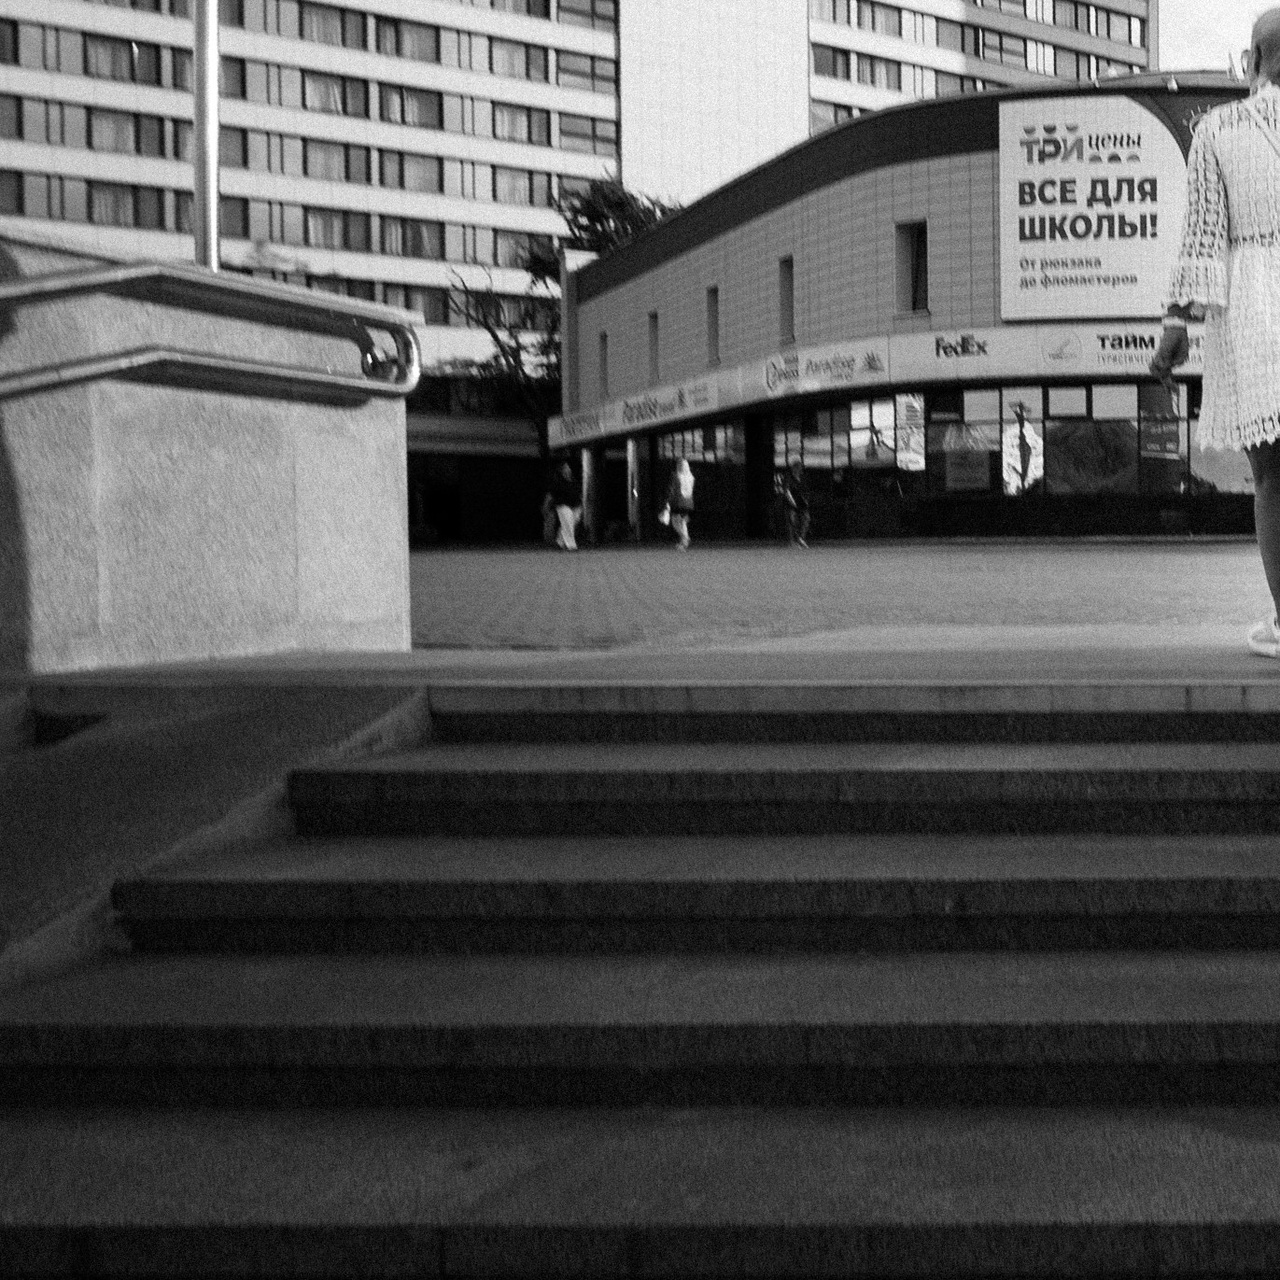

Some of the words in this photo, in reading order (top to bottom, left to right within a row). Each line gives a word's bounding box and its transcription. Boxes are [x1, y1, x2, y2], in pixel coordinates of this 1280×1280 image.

[1018, 177, 1077, 206] ВСЕ
[1086, 176, 1158, 208] ДЛЯ
[1018, 212, 1158, 242] ШКОЛЫ!
[935, 333, 988, 358] FedEx
